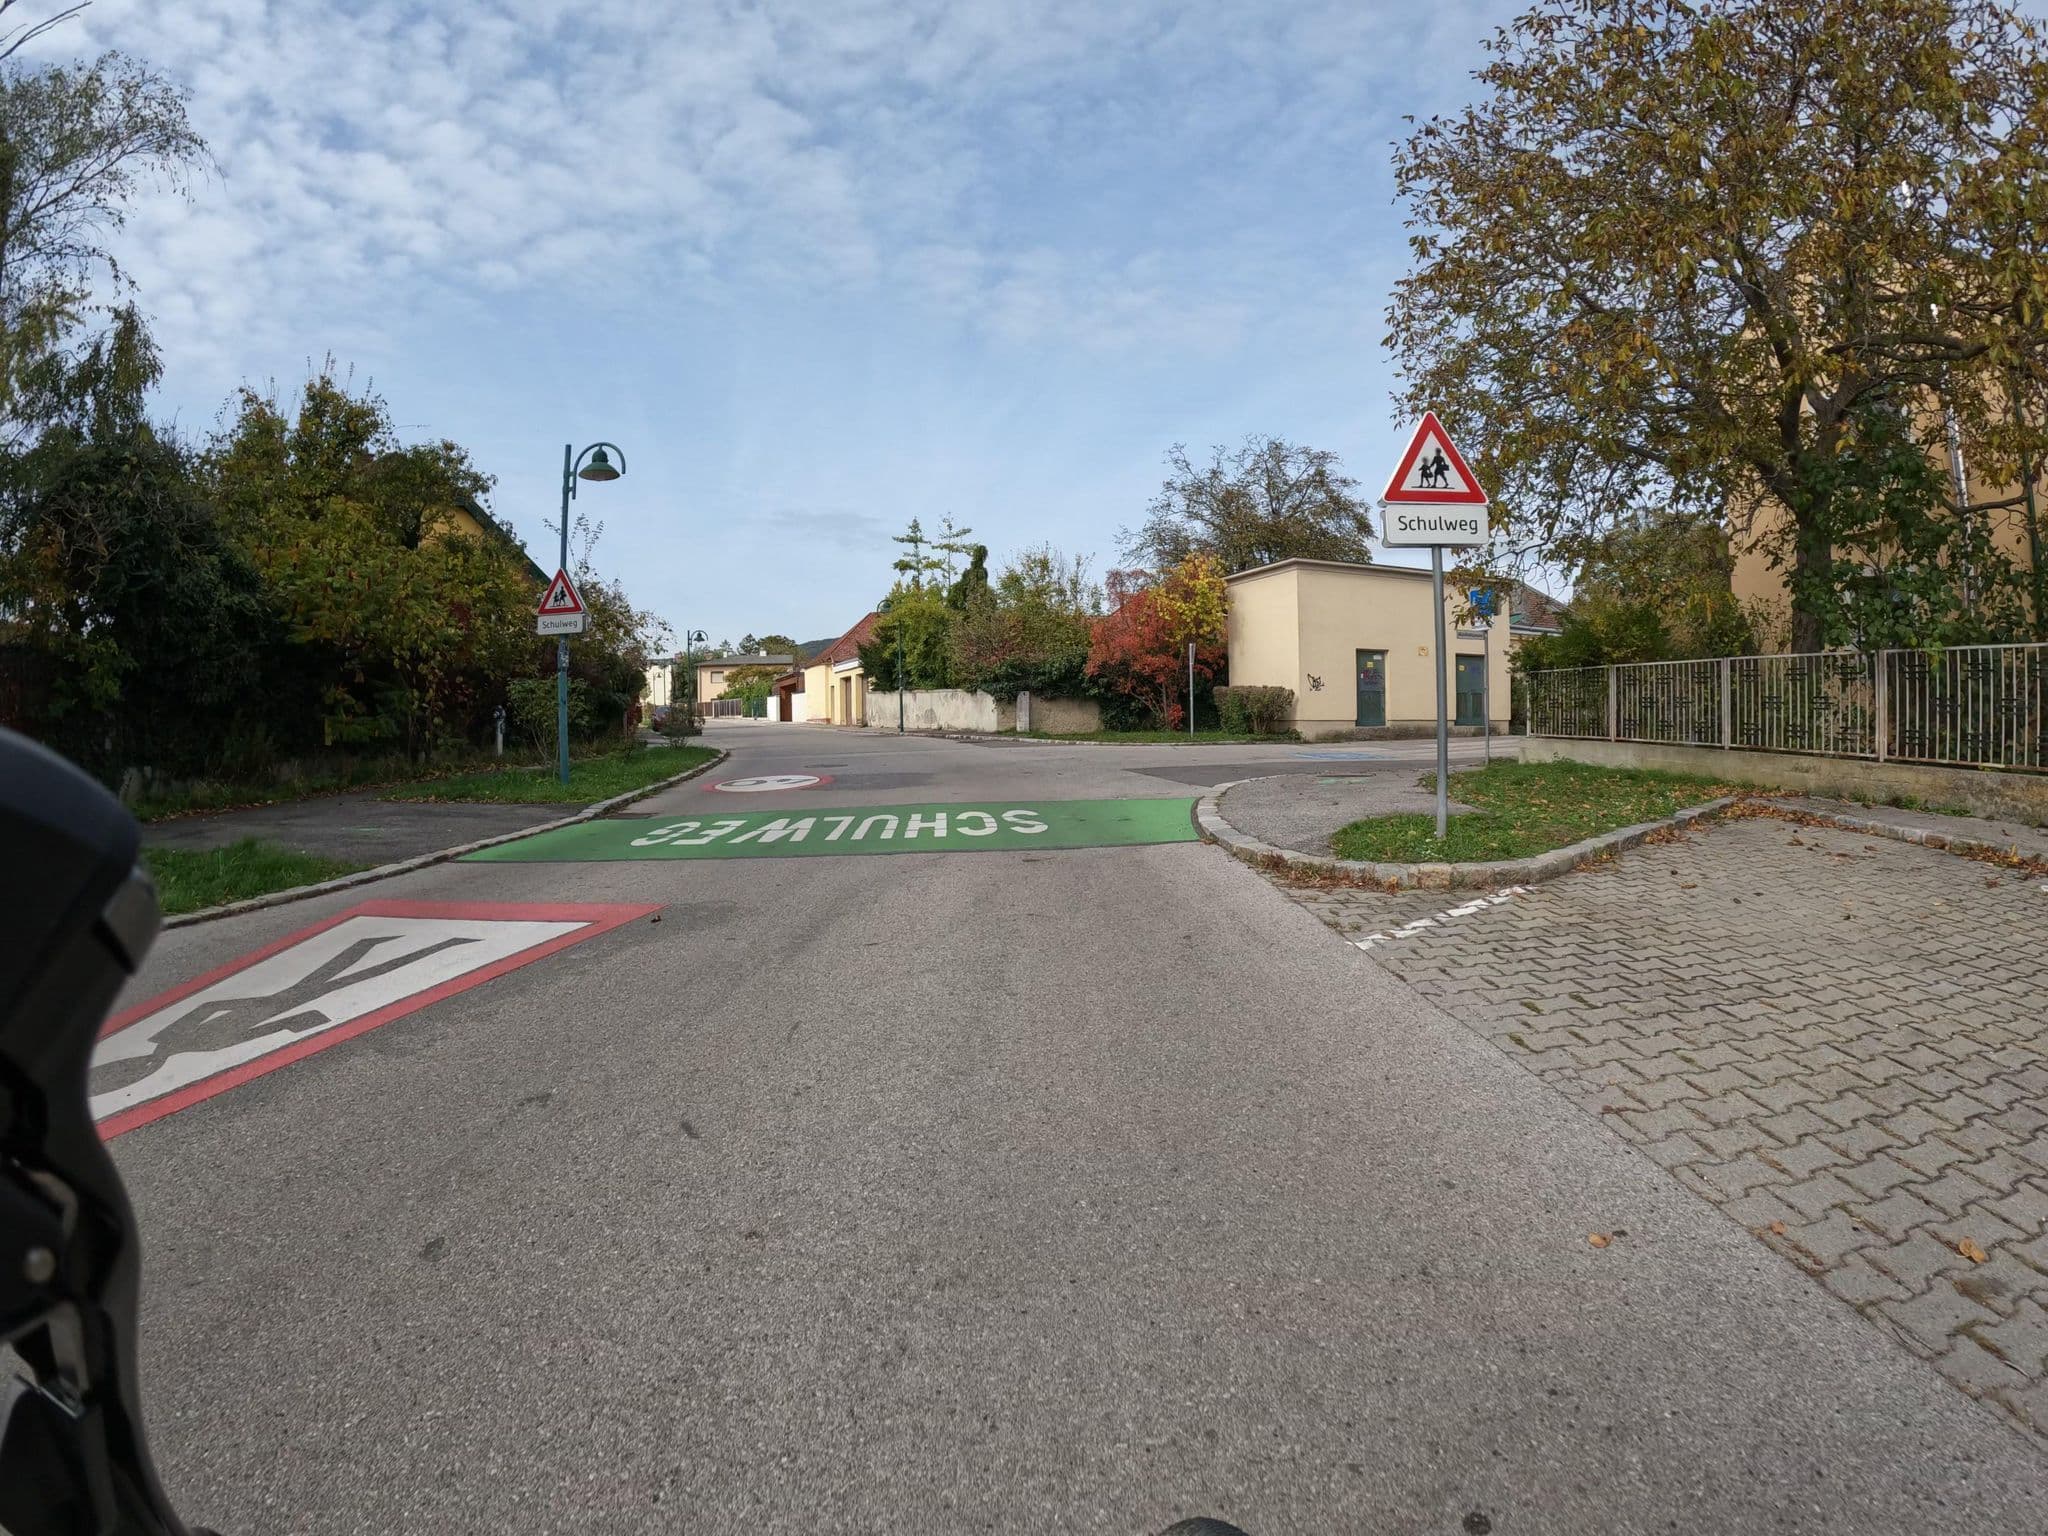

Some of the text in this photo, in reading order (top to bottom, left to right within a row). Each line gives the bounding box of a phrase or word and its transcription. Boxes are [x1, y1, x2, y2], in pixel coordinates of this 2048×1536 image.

[1398, 515, 1478, 535] Schulweg
[542, 620, 578, 630] Schulweg
[630, 809, 1049, 847] SCHULWEG
